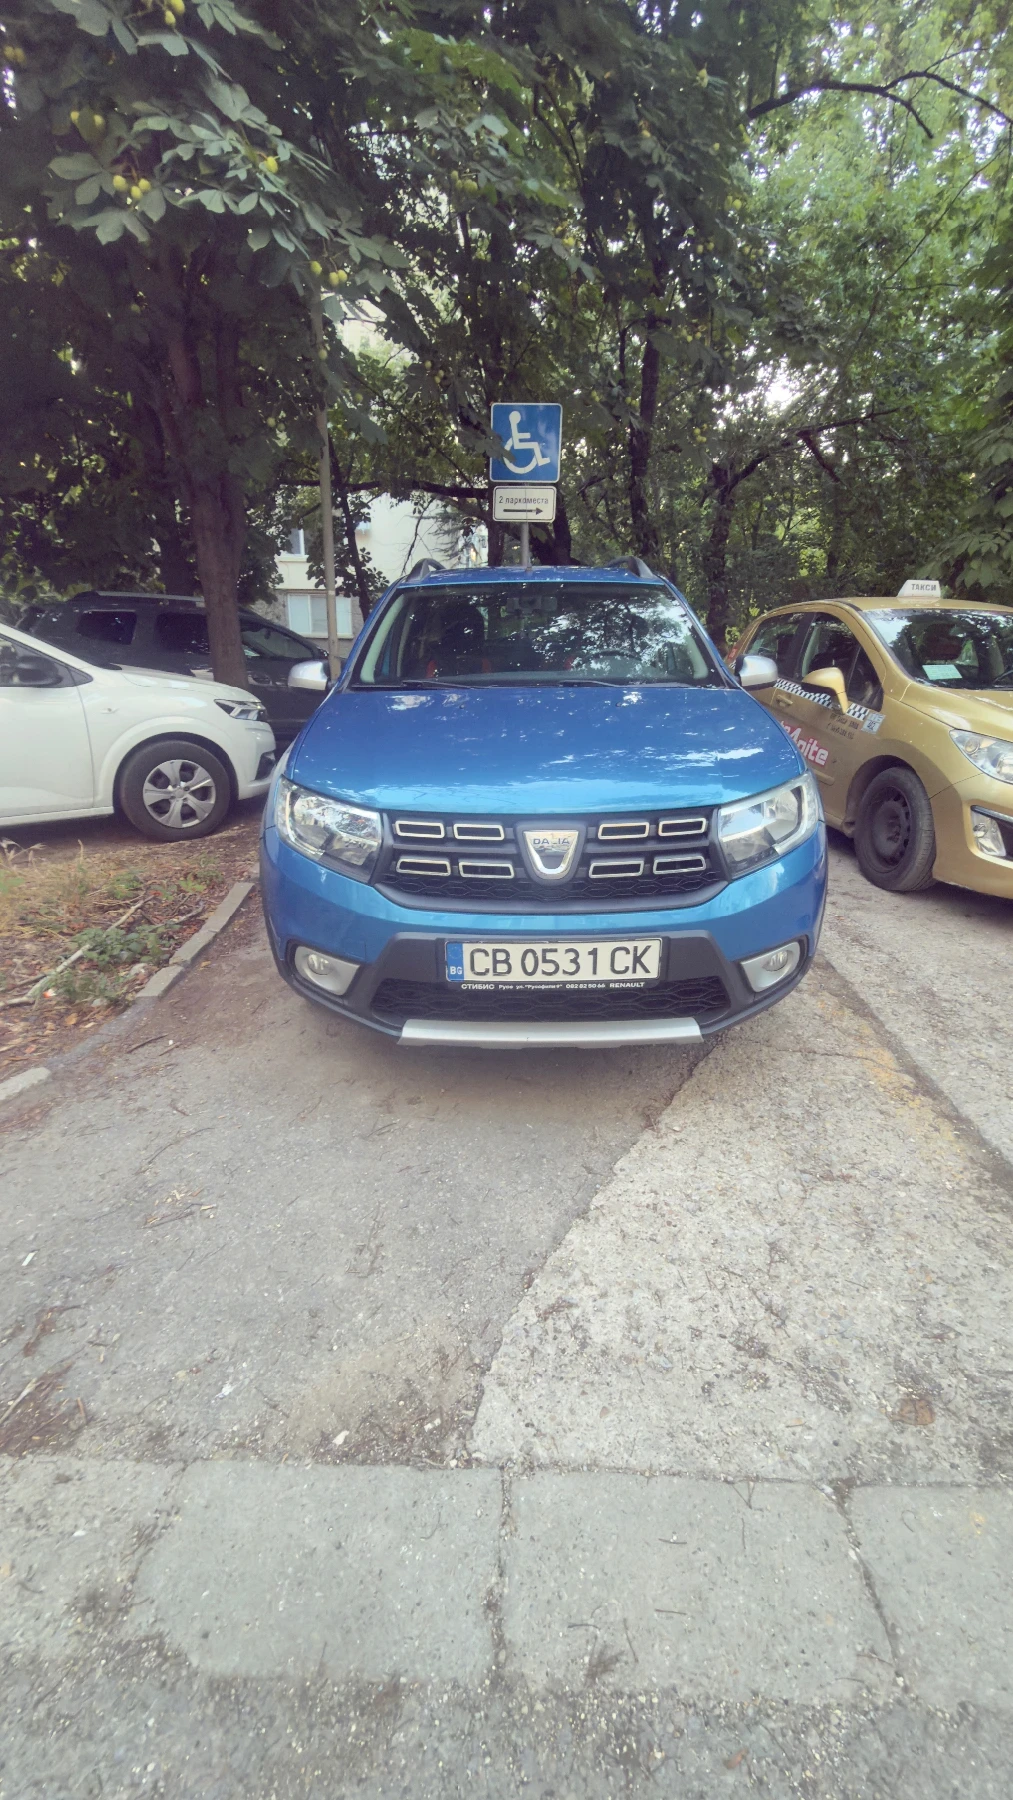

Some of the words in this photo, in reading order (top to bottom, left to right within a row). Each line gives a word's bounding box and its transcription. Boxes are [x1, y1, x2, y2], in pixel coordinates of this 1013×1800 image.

[498, 495, 504, 504] 2
[505, 497, 549, 505] паркоместа
[911, 583, 937, 591] ТАКСИ
[520, 947, 598, 977] 0531
[449, 966, 463, 975] BG
